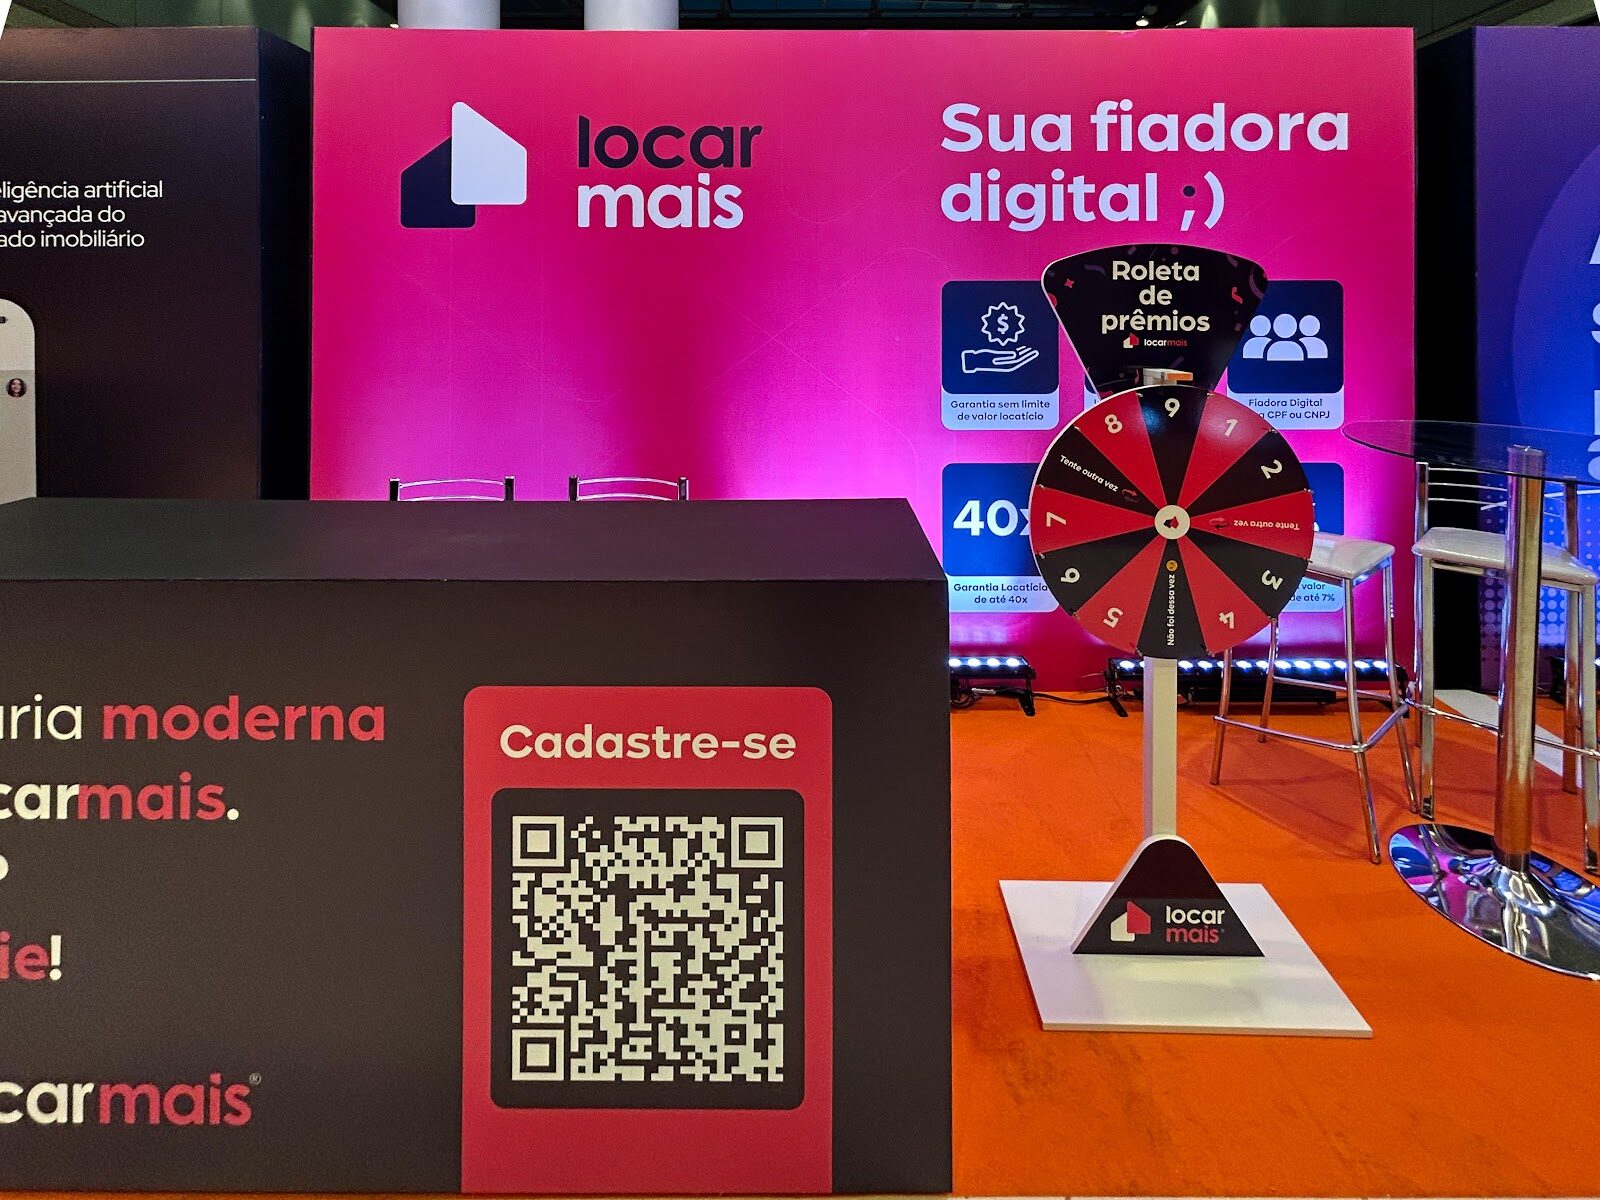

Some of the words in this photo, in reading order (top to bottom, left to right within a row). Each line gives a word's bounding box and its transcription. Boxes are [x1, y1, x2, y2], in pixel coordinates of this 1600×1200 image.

[941, 103, 1072, 152] Sua
[1090, 99, 1349, 152] fiadora
[578, 115, 763, 168] locar
[0, 180, 79, 203] ligência
[84, 180, 163, 198] artificial
[941, 169, 1158, 232] digital
[578, 173, 743, 229] mais
[98, 205, 126, 223] do
[40, 229, 145, 247] imobiliário
[1112, 260, 1200, 281] Roleta
[1139, 285, 1173, 305] de
[1101, 308, 1211, 335] prêmios
[1143, 338, 1188, 347] locarmais
[950, 400, 996, 409] Garantia
[997, 400, 1020, 409] sem
[1021, 400, 1051, 409] limite
[1164, 398, 1180, 418] 9
[1248, 398, 1288, 407] Fiadora
[1289, 398, 1323, 409] Digital
[957, 412, 970, 421] de
[971, 412, 998, 421] valor
[999, 412, 1044, 421] locatício
[1104, 413, 1123, 434] 8
[1267, 410, 1288, 419] CPF
[1289, 411, 1302, 419] ou
[1303, 410, 1330, 419] CNPJ
[1224, 418, 1238, 437] 1
[1060, 454, 1082, 472] Tente
[1081, 468, 1104, 484] outra
[1104, 480, 1119, 492] vez
[1260, 459, 1283, 480] 2
[1046, 511, 1067, 527] 7
[1233, 519, 1249, 527] vez
[1250, 520, 1274, 528] outra
[1275, 521, 1300, 531] Tente
[1060, 567, 1081, 584] 6
[1261, 569, 1284, 591] 3
[953, 583, 999, 592] Garantia
[1001, 583, 1048, 592] Locatícia
[1301, 582, 1325, 590] valor
[974, 595, 987, 604] de
[989, 594, 1006, 604] até
[1008, 595, 1028, 604] 40x
[1167, 590, 1175, 615] dessa
[1303, 592, 1320, 601] até
[1321, 593, 1336, 602] 7%
[1103, 607, 1124, 629] 5
[1166, 616, 1175, 627] foi
[1218, 611, 1235, 629] 4
[1167, 628, 1175, 646] Não
[0, 693, 83, 740] ria
[103, 694, 385, 741] moderna
[500, 723, 797, 759] Cadastre-se
[1165, 905, 1226, 925] locar
